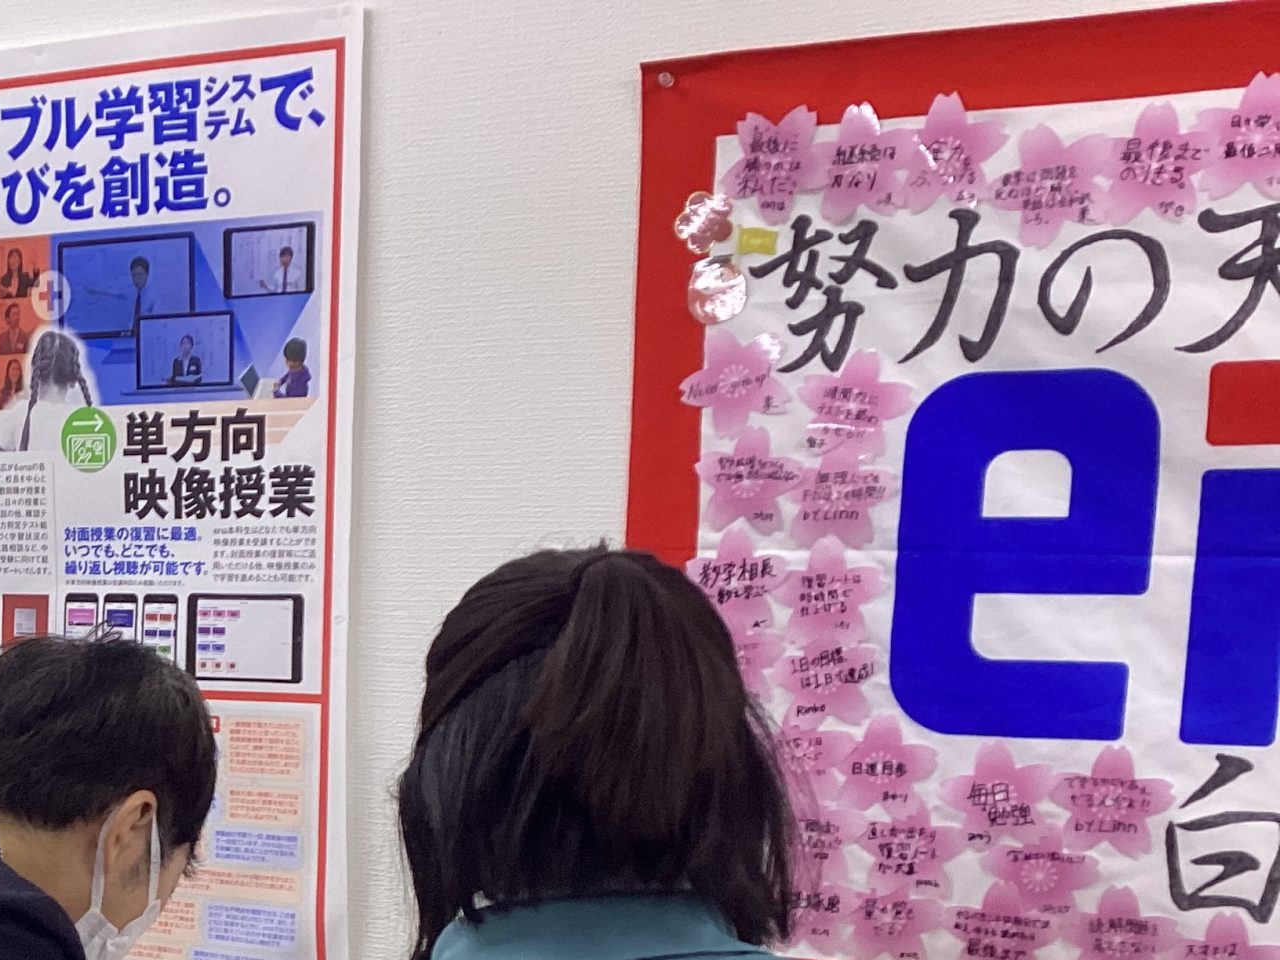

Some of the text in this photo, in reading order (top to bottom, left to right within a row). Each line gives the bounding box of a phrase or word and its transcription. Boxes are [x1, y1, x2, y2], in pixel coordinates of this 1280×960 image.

[122, 407, 266, 464] 単方向
[123, 464, 316, 521] 映像授業
[64, 526, 202, 541] 対面授業の復習に最適。
[64, 543, 176, 558] いつでも、どこでも、
[64, 560, 209, 576] 繰り返し視聴が可能です。
